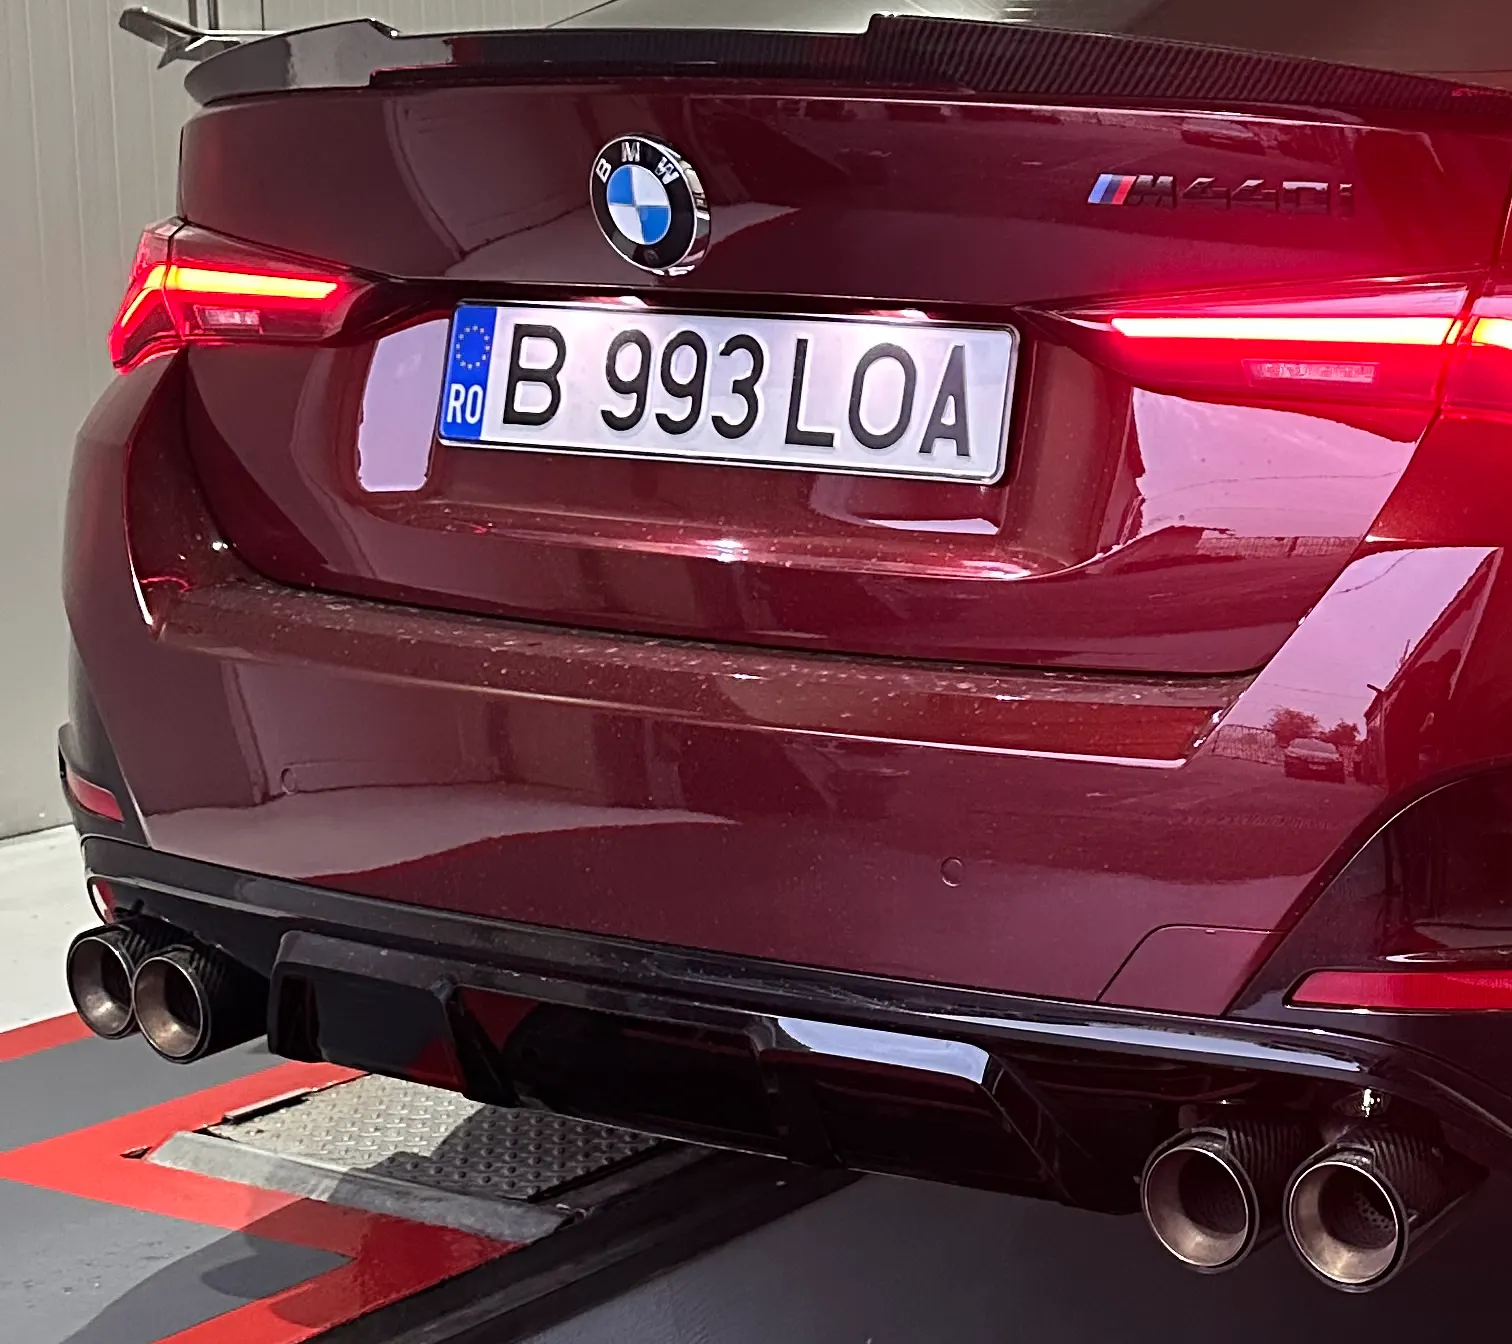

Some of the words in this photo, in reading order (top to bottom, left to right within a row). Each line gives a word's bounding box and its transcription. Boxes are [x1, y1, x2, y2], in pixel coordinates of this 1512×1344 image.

[595, 141, 680, 184] BMW
[447, 382, 484, 425] RO
[503, 323, 567, 427] B
[600, 328, 765, 440] 993
[784, 338, 971, 457] LOA
